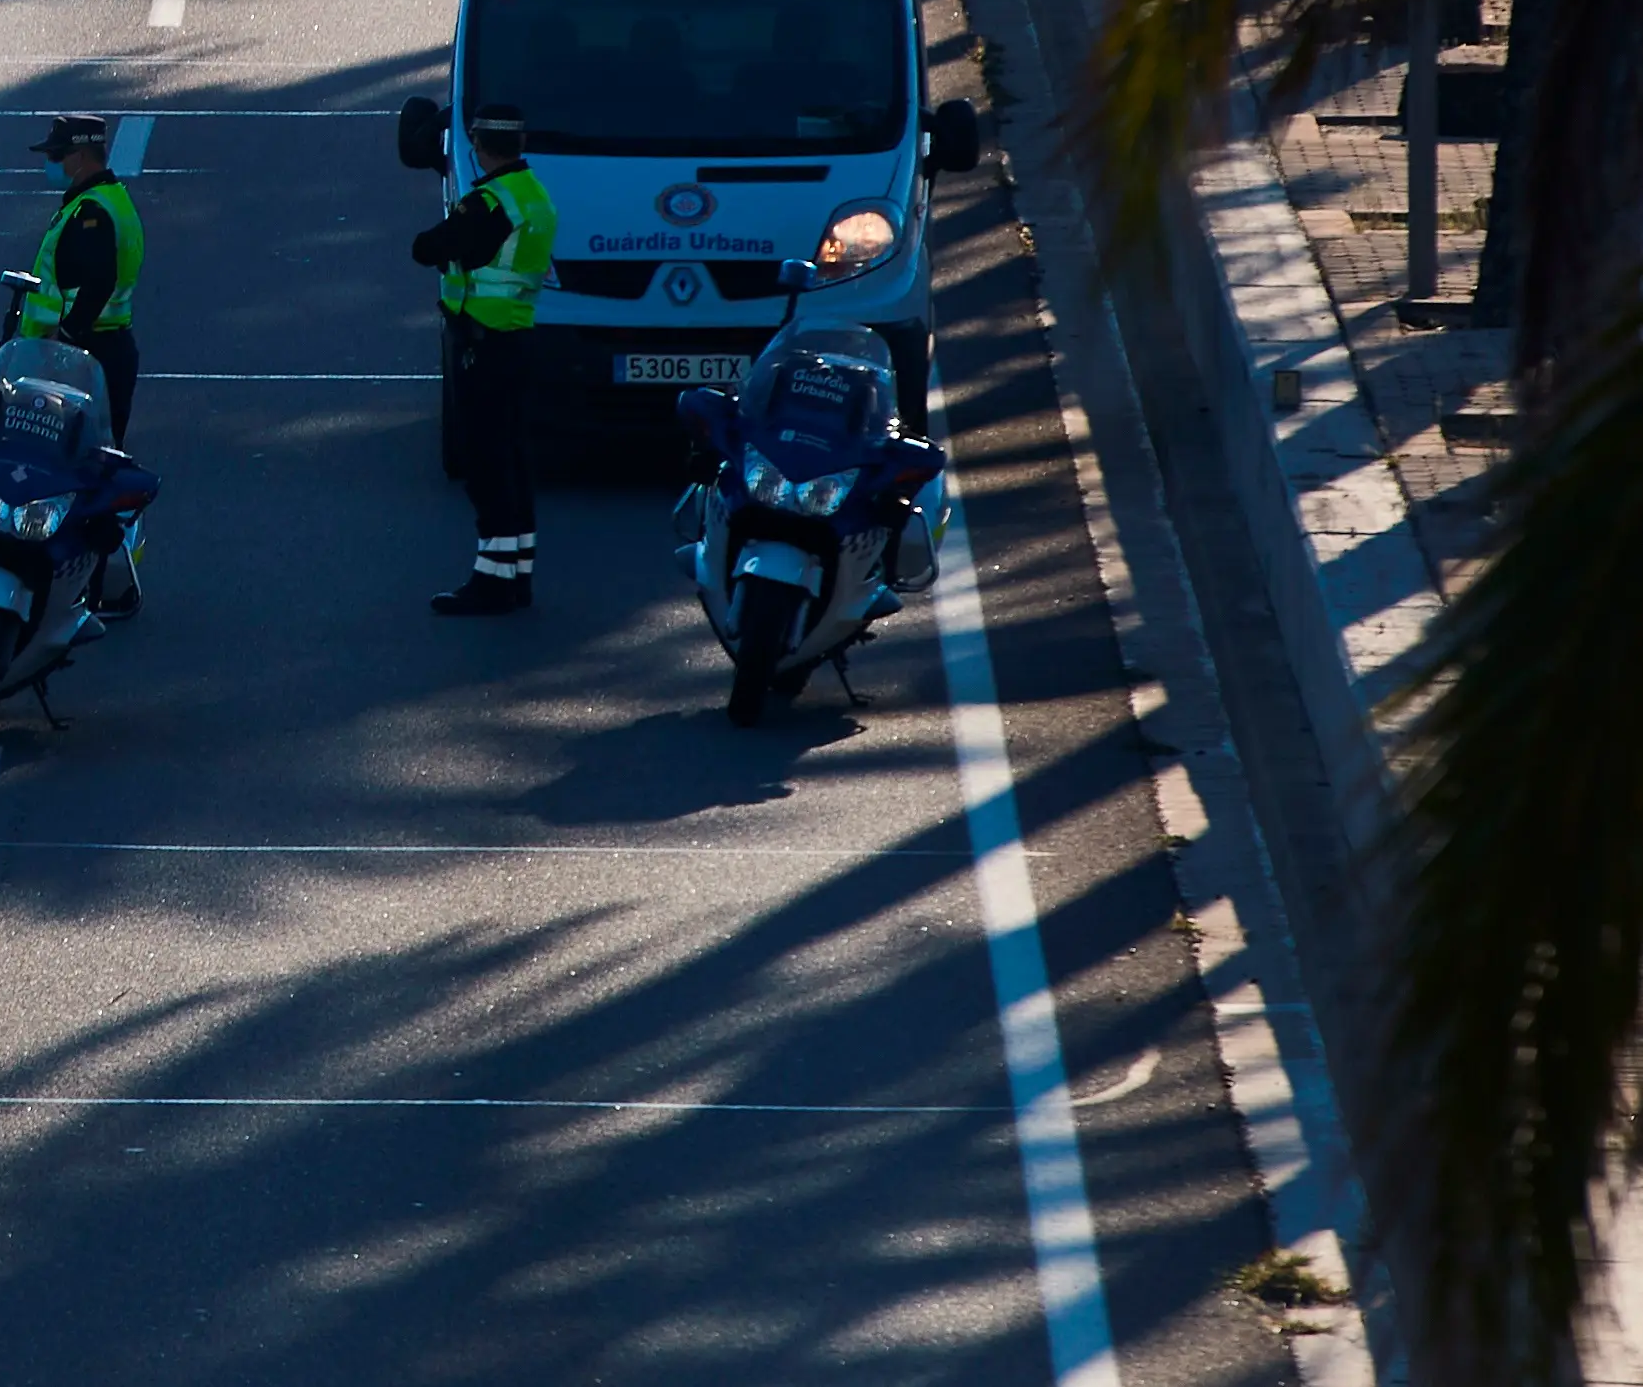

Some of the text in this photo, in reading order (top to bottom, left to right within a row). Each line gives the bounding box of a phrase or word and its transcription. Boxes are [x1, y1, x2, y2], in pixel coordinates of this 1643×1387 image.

[689, 232, 775, 255] Urbana
[629, 357, 742, 380] 5306 GTX
[791, 381, 844, 404] Urbana
[4, 417, 59, 442] Urbana
